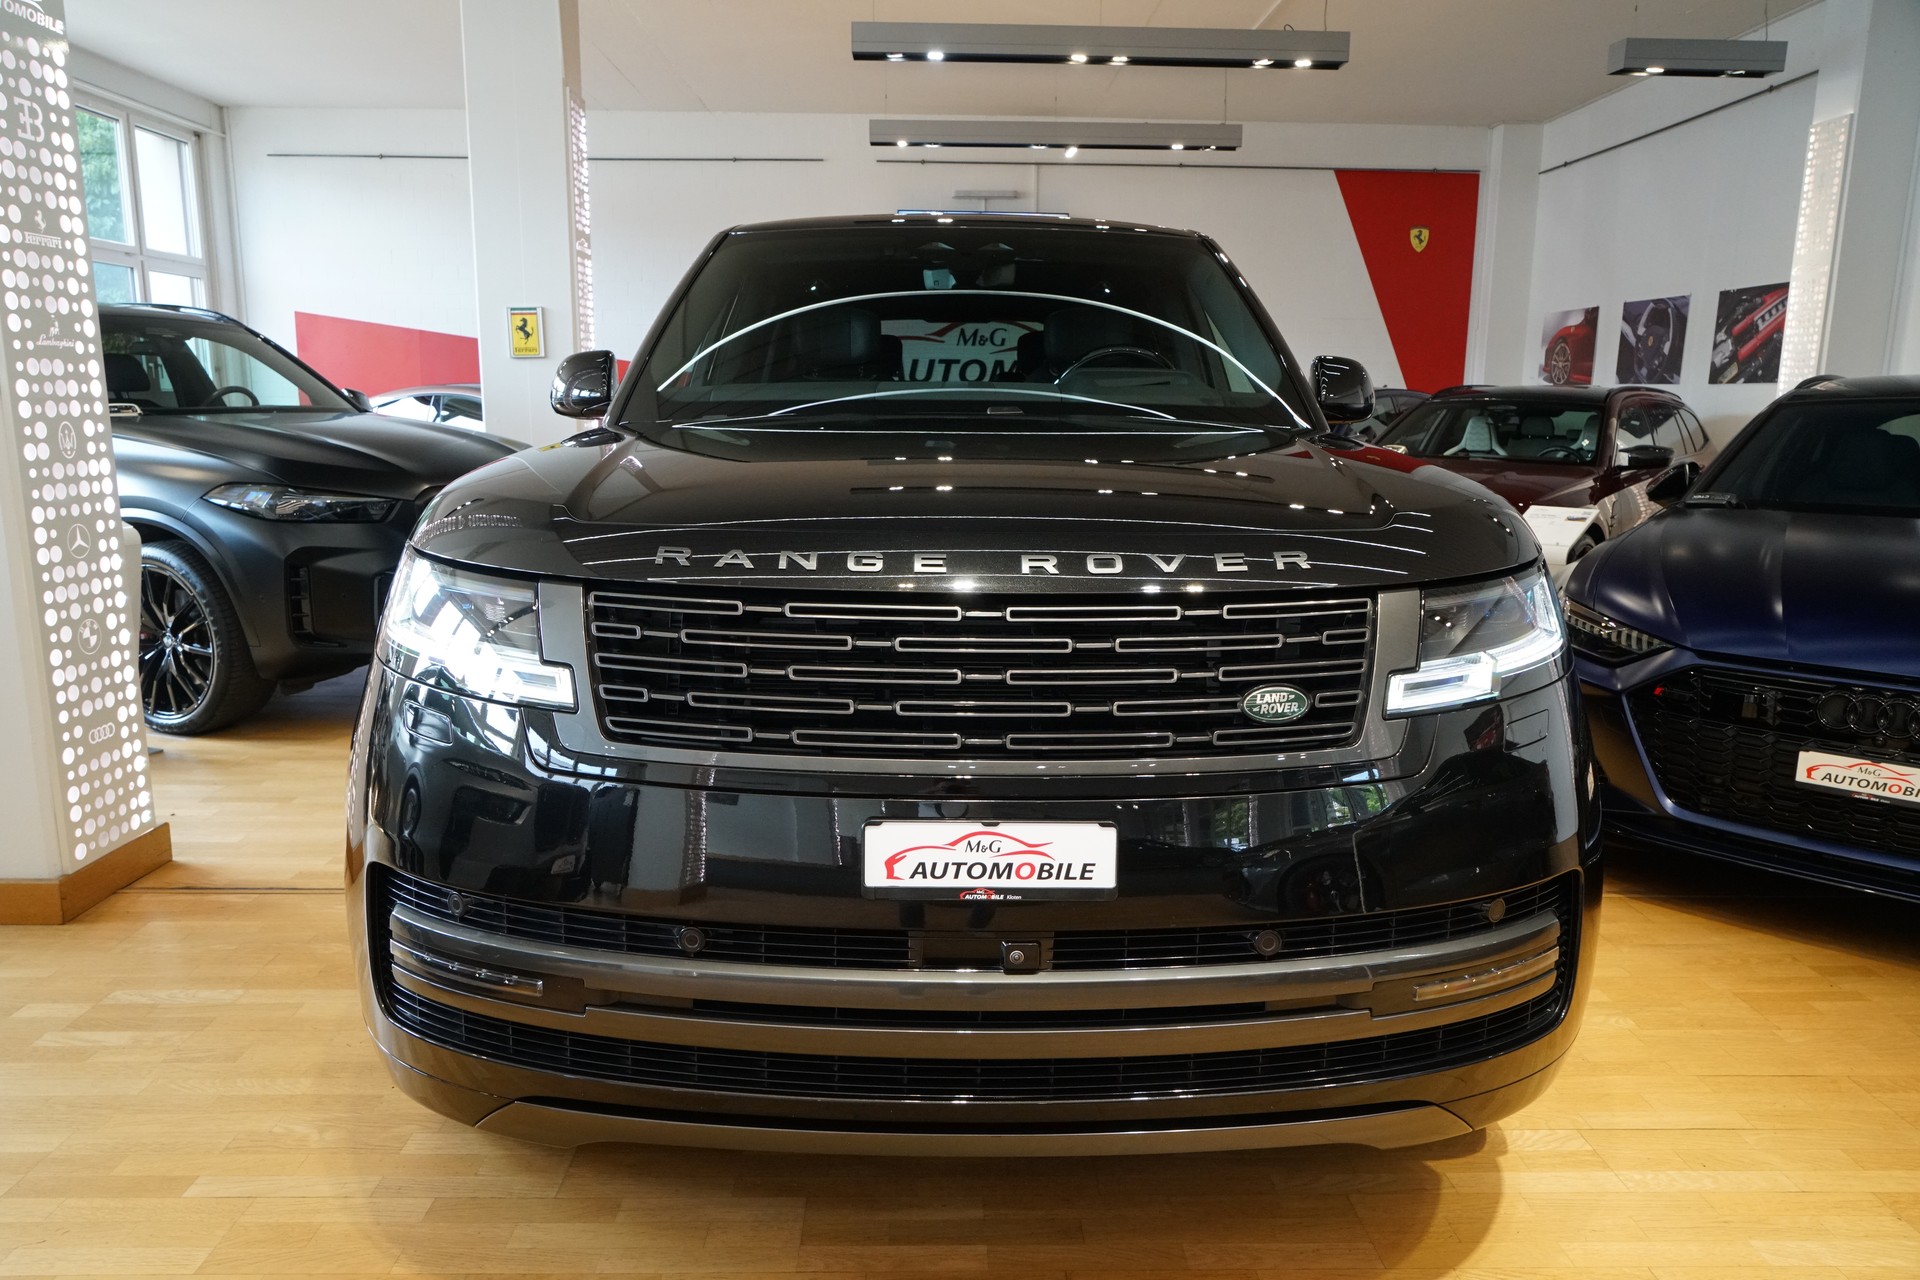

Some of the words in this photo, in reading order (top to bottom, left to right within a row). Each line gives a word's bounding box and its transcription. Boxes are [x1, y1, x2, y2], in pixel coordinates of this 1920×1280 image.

[956, 328, 1008, 347] M&G
[654, 545, 948, 574] RANGE
[1020, 550, 1312, 575] ROVER
[1256, 692, 1289, 704] LAND
[1260, 702, 1299, 714] ROVER
[1857, 766, 1882, 777] M&G
[964, 839, 1003, 853] M&G
[909, 861, 1097, 881] AUTOMOBILE
